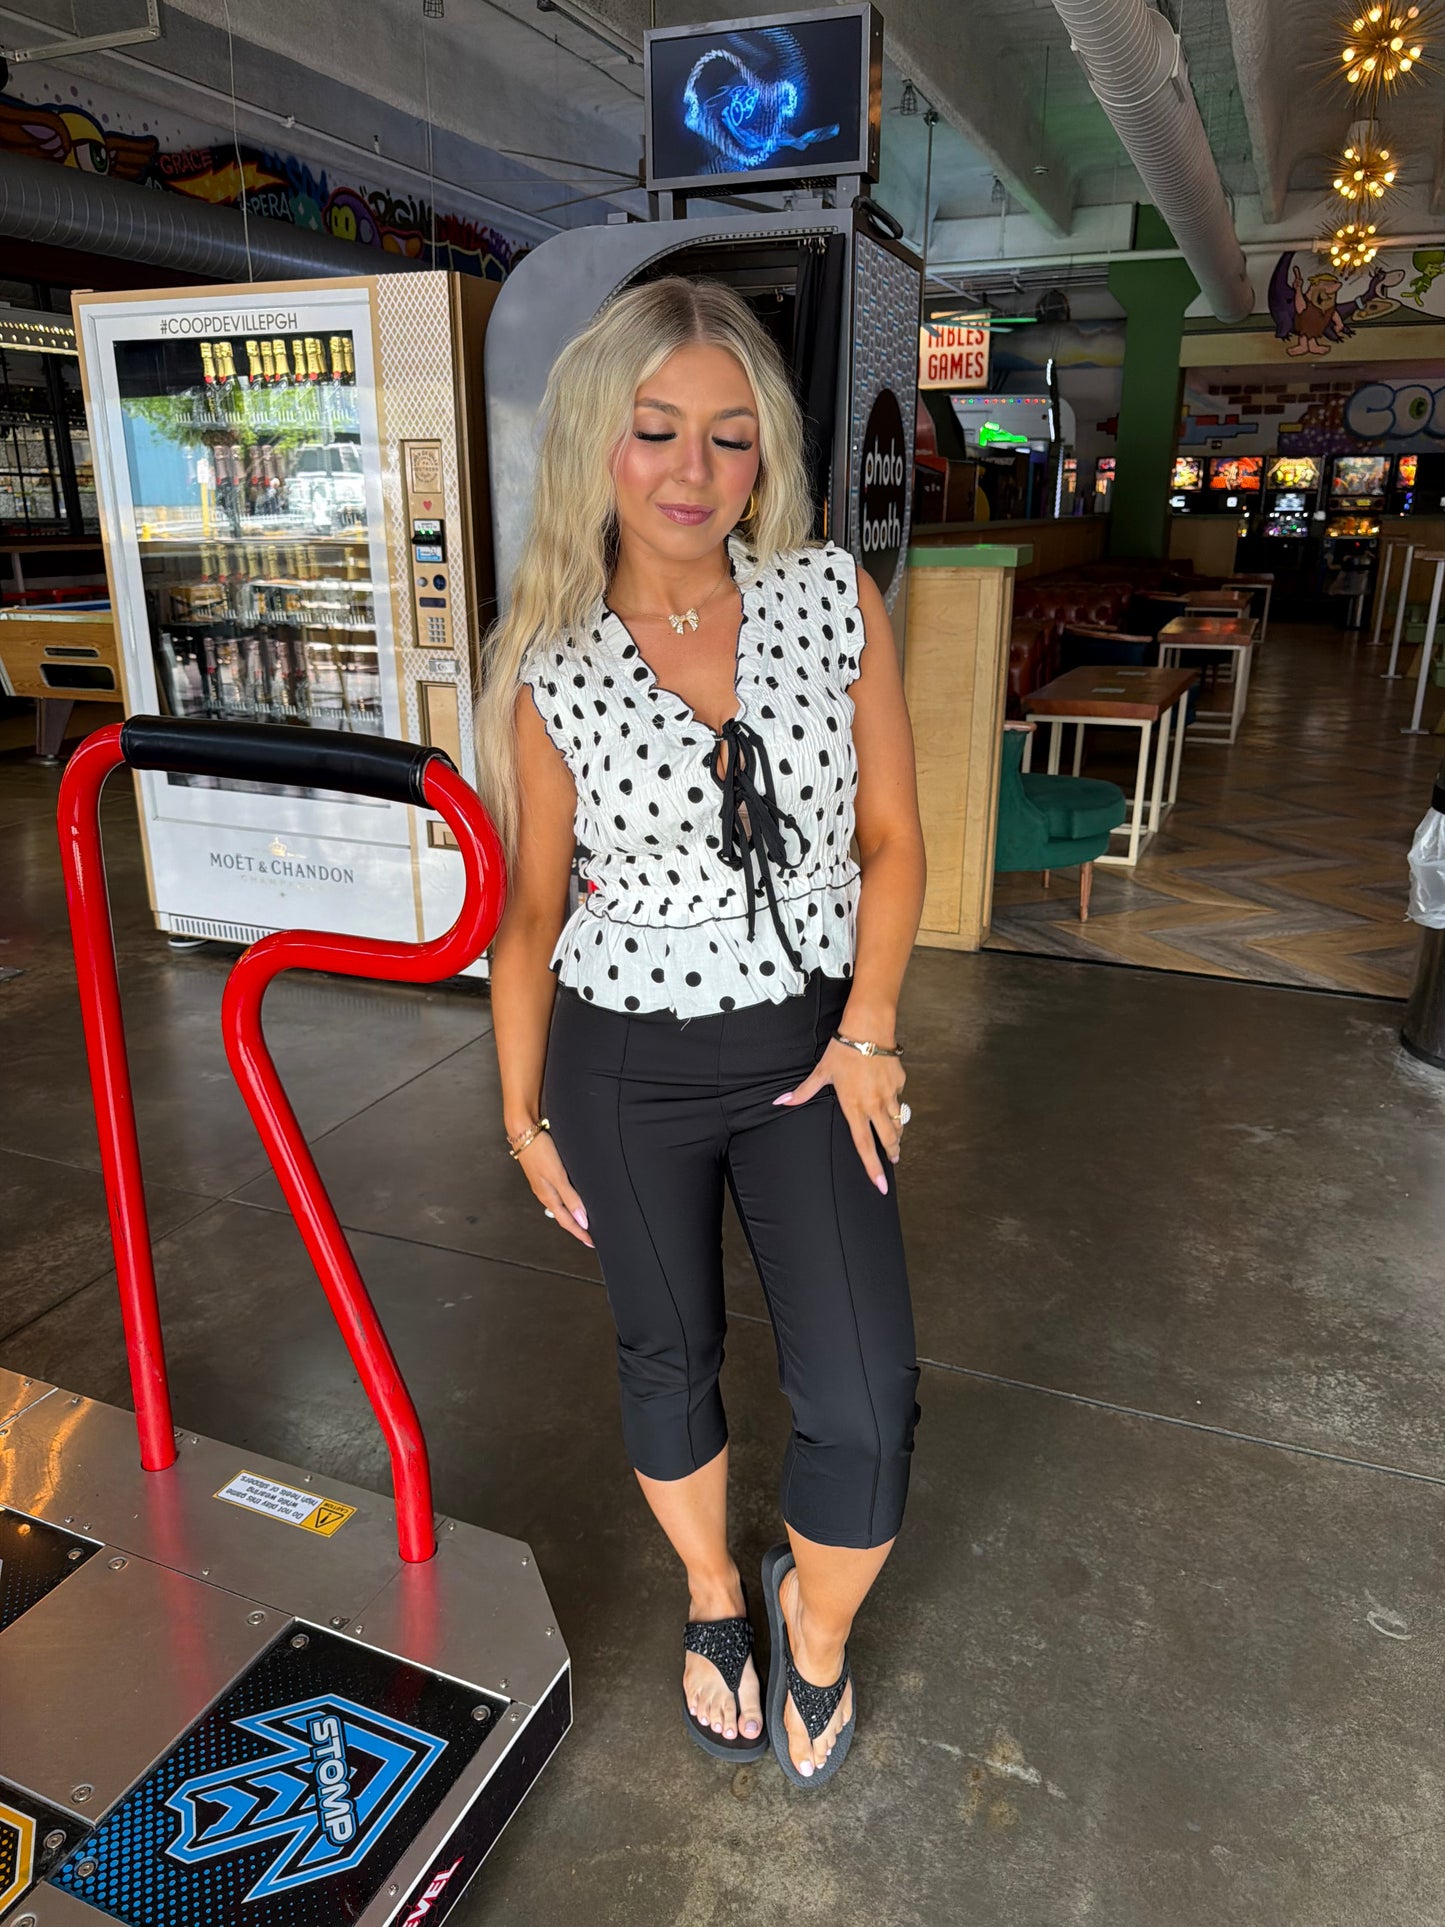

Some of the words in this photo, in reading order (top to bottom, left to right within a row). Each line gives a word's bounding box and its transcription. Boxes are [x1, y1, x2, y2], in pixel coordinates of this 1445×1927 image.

[160, 149, 213, 175] GRACE
[160, 312, 298, 335] #COOPDEVILLEPGH
[928, 351, 984, 381] GAMES
[865, 435, 903, 493] photo
[863, 502, 900, 552] booth
[210, 852, 254, 872] MOËT
[258, 860, 268, 873] &
[271, 859, 354, 884] CHANDON
[225, 1488, 246, 1499] game
[246, 1486, 277, 1500] wearing
[281, 1489, 301, 1499] heels
[248, 1495, 262, 1505] this
[279, 1498, 299, 1508] while
[302, 1496, 319, 1507] high
[261, 1501, 278, 1513] play
[279, 1506, 293, 1517] not
[324, 1503, 349, 1514] CAUTION
[292, 1511, 304, 1520] Do
[311, 1716, 355, 1843] STOMP
